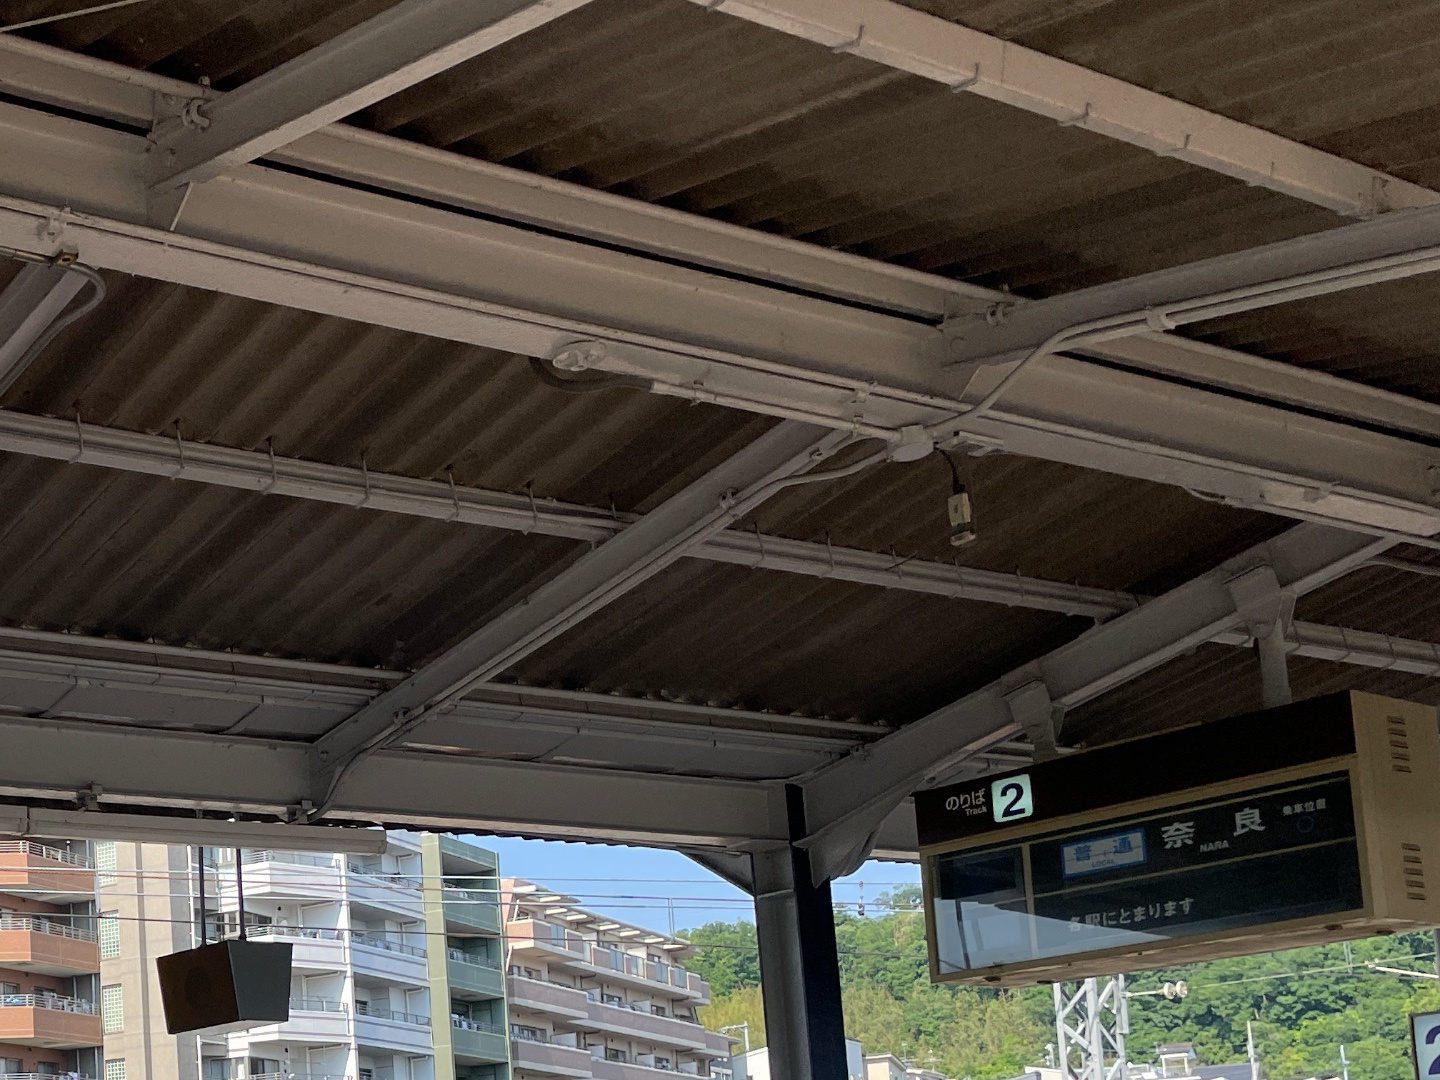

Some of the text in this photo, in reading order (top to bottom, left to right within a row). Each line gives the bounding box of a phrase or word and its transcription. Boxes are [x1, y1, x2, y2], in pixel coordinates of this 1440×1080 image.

[945, 788, 987, 811] のりば
[965, 805, 987, 817] Track
[1000, 782, 1026, 818] 2
[1199, 840, 1230, 852] NARA
[1067, 897, 1194, 932] 各駅にとまります
